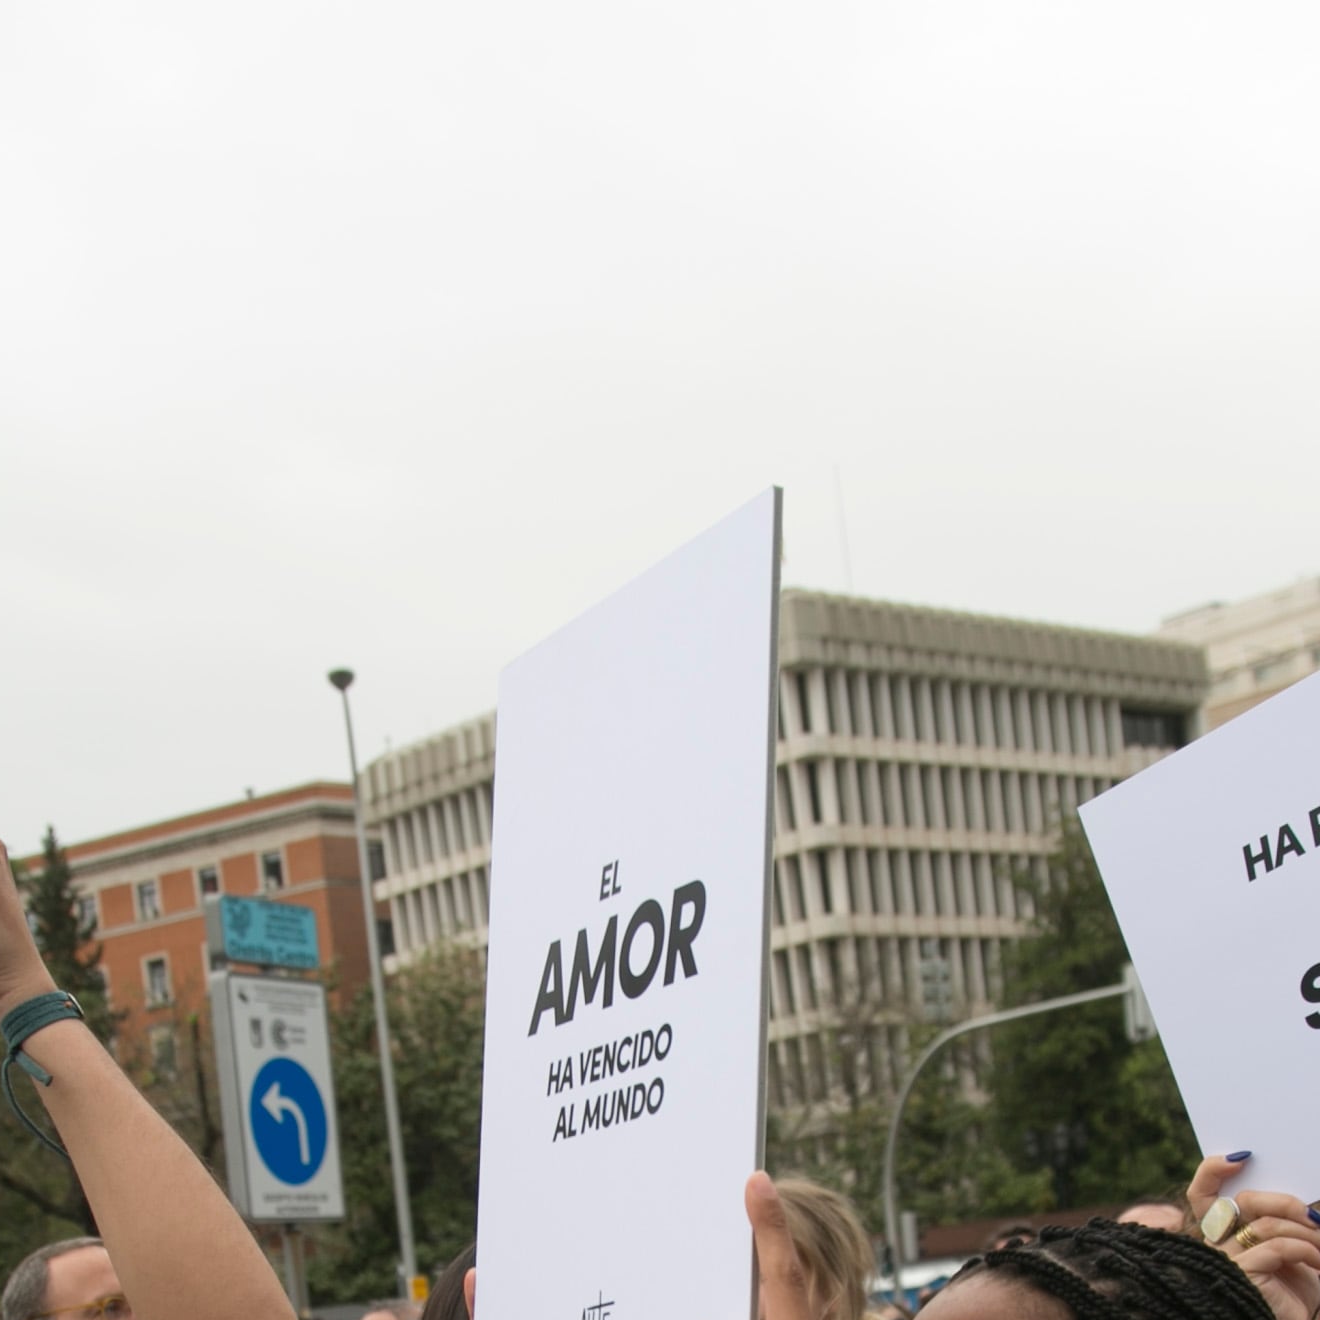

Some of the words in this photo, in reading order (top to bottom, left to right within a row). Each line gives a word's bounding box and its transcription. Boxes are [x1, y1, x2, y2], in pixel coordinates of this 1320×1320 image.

[599, 860, 622, 902] EL
[1242, 823, 1306, 883] HA
[527, 879, 707, 1037] AMOR
[547, 1060, 573, 1097] HA
[579, 1022, 673, 1087] VENCIDO
[552, 1105, 577, 1143] AL
[581, 1077, 665, 1135] MUNDO
